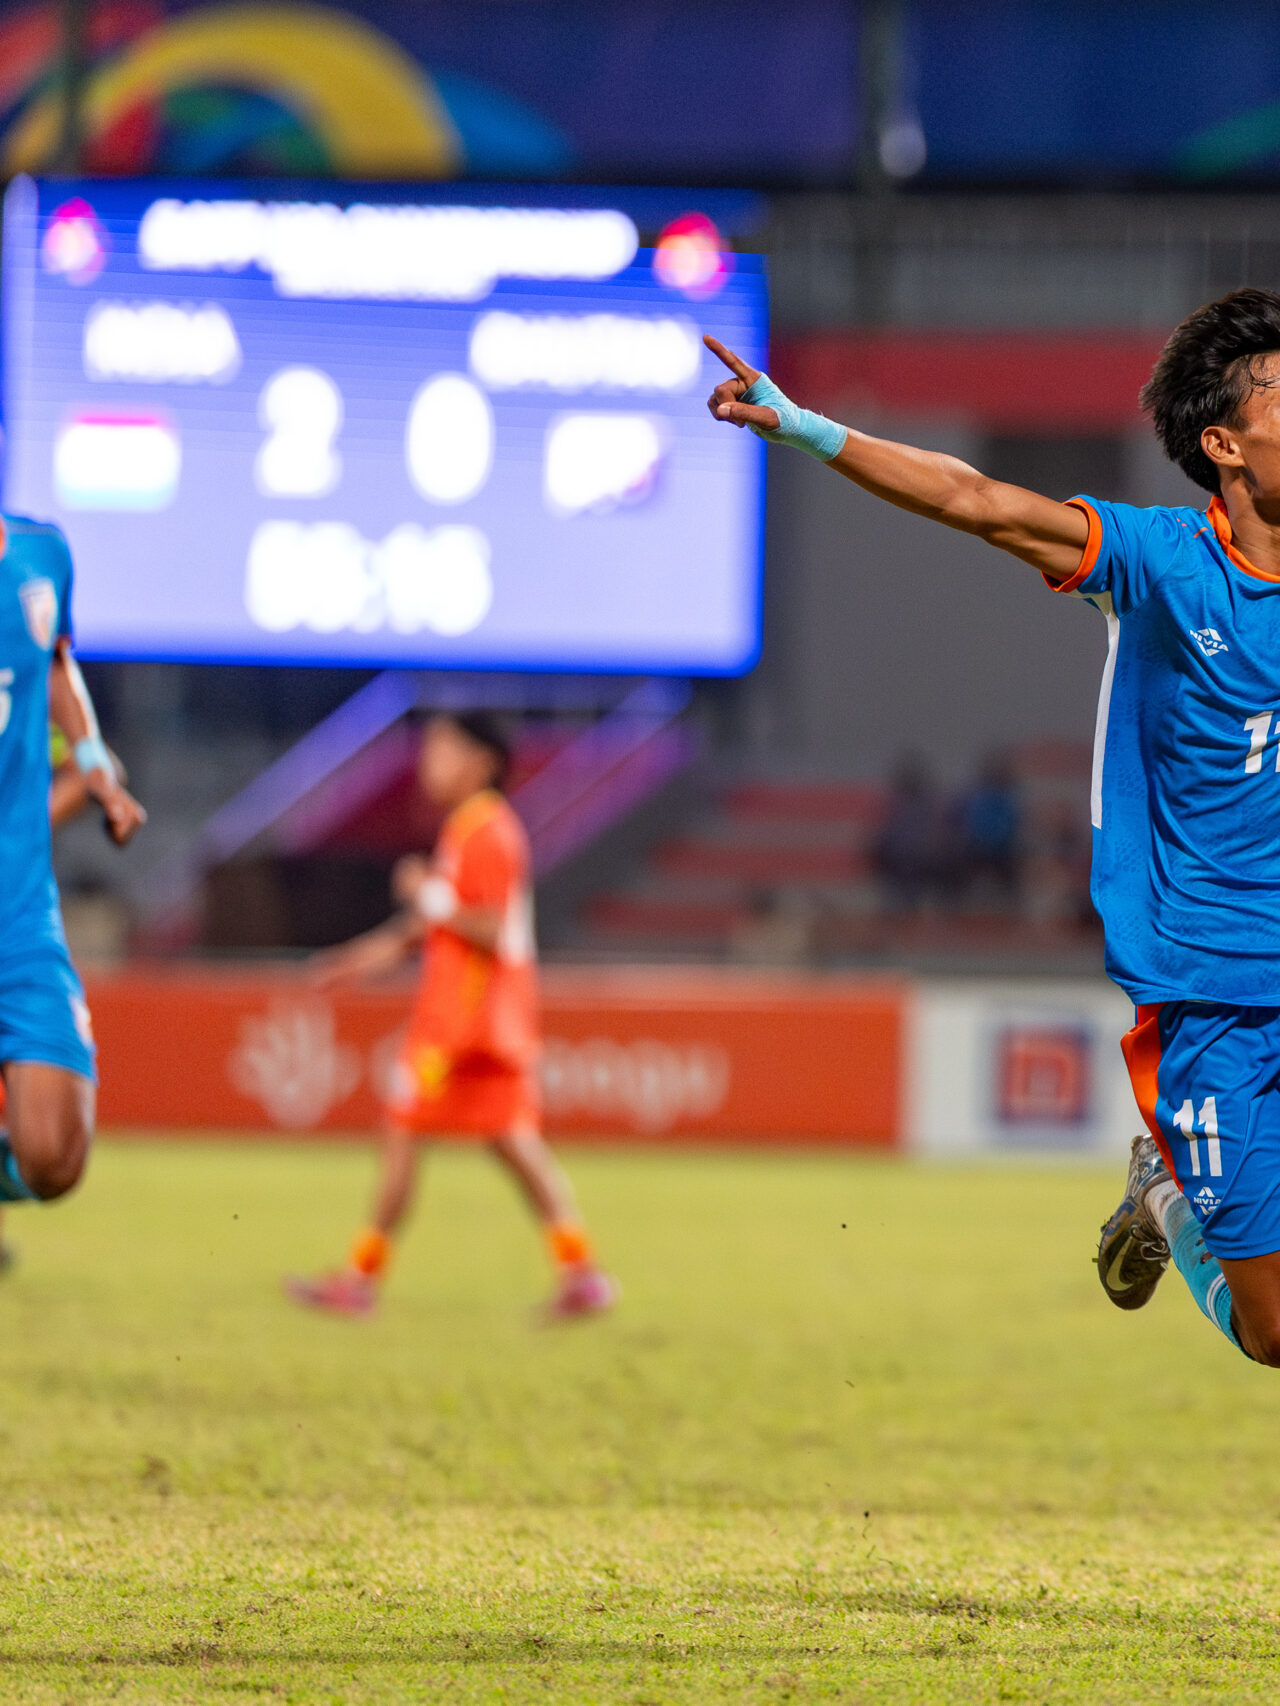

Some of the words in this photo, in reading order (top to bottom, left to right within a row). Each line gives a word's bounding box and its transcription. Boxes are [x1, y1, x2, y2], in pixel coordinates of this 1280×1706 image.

[405, 370, 495, 506] 0
[1189, 629, 1229, 652] NIVIA
[1172, 1096, 1222, 1177] 11
[1193, 1196, 1222, 1205] NIVIA
